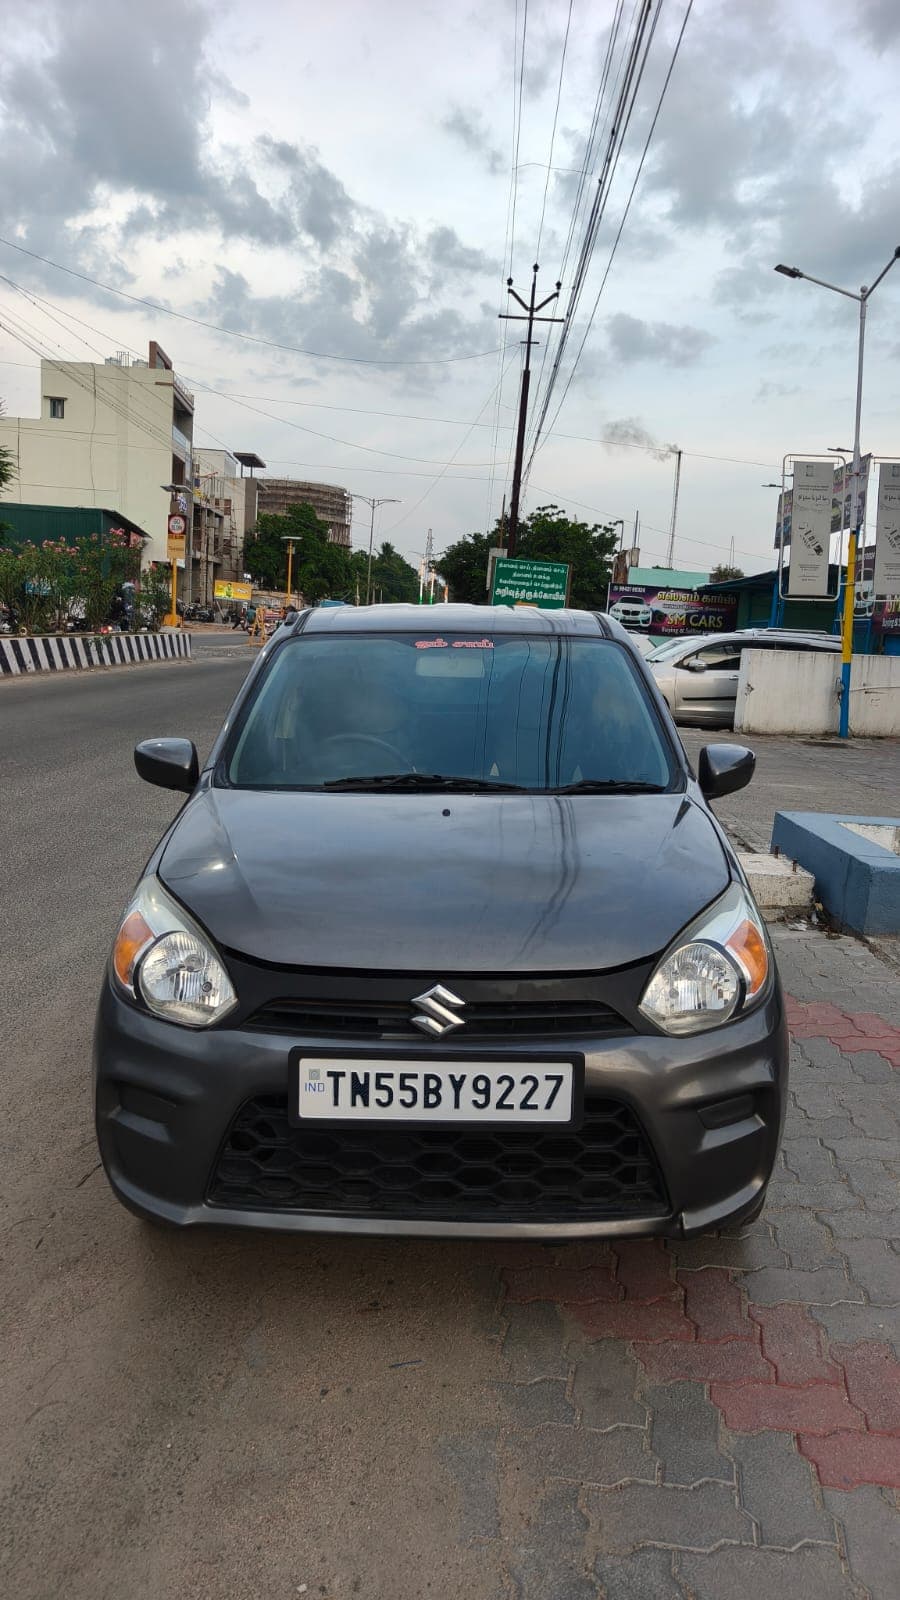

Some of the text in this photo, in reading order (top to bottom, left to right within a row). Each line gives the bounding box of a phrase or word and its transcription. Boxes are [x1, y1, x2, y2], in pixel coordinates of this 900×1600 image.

[667, 613, 723, 628] SM CARS
[304, 1070, 564, 1111] IND TN55BY9227
